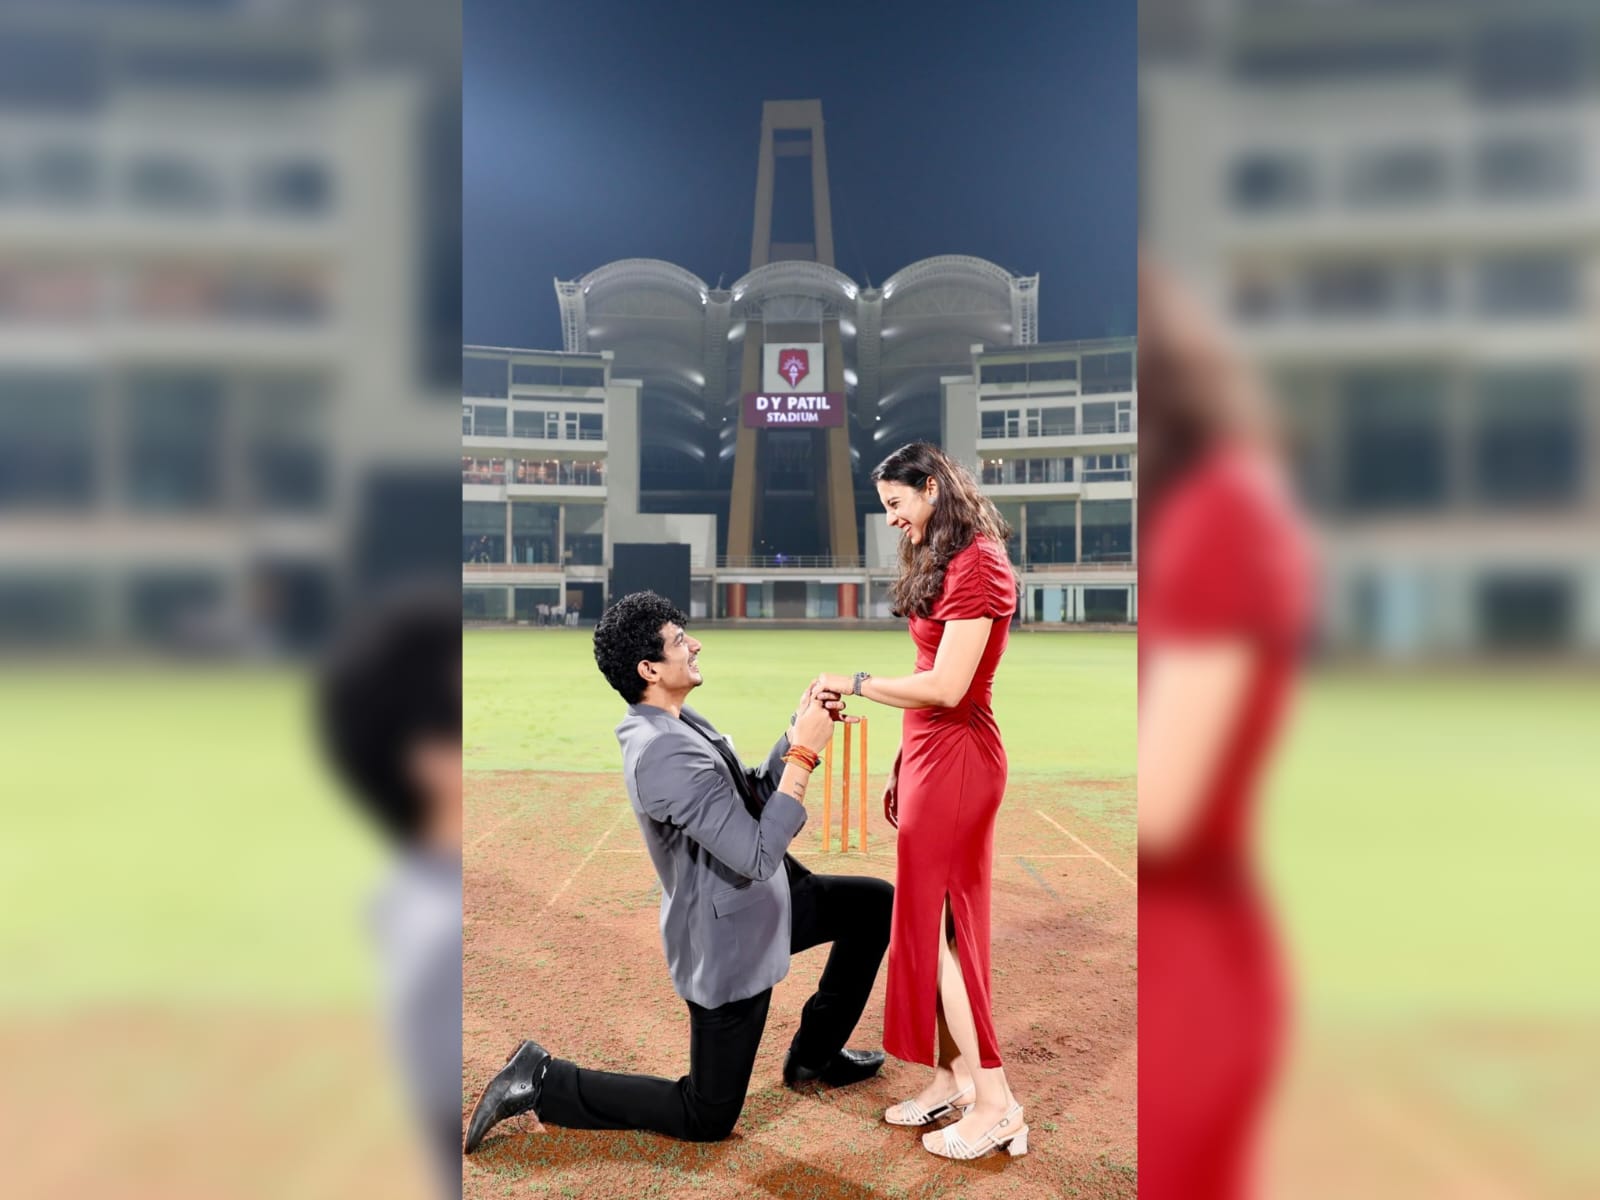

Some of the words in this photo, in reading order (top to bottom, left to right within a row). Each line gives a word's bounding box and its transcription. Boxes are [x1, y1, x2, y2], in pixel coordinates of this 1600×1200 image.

[756, 396, 769, 410] D
[770, 396, 782, 410] Y
[787, 396, 831, 410] PATIL
[766, 411, 819, 423] STADIUM
